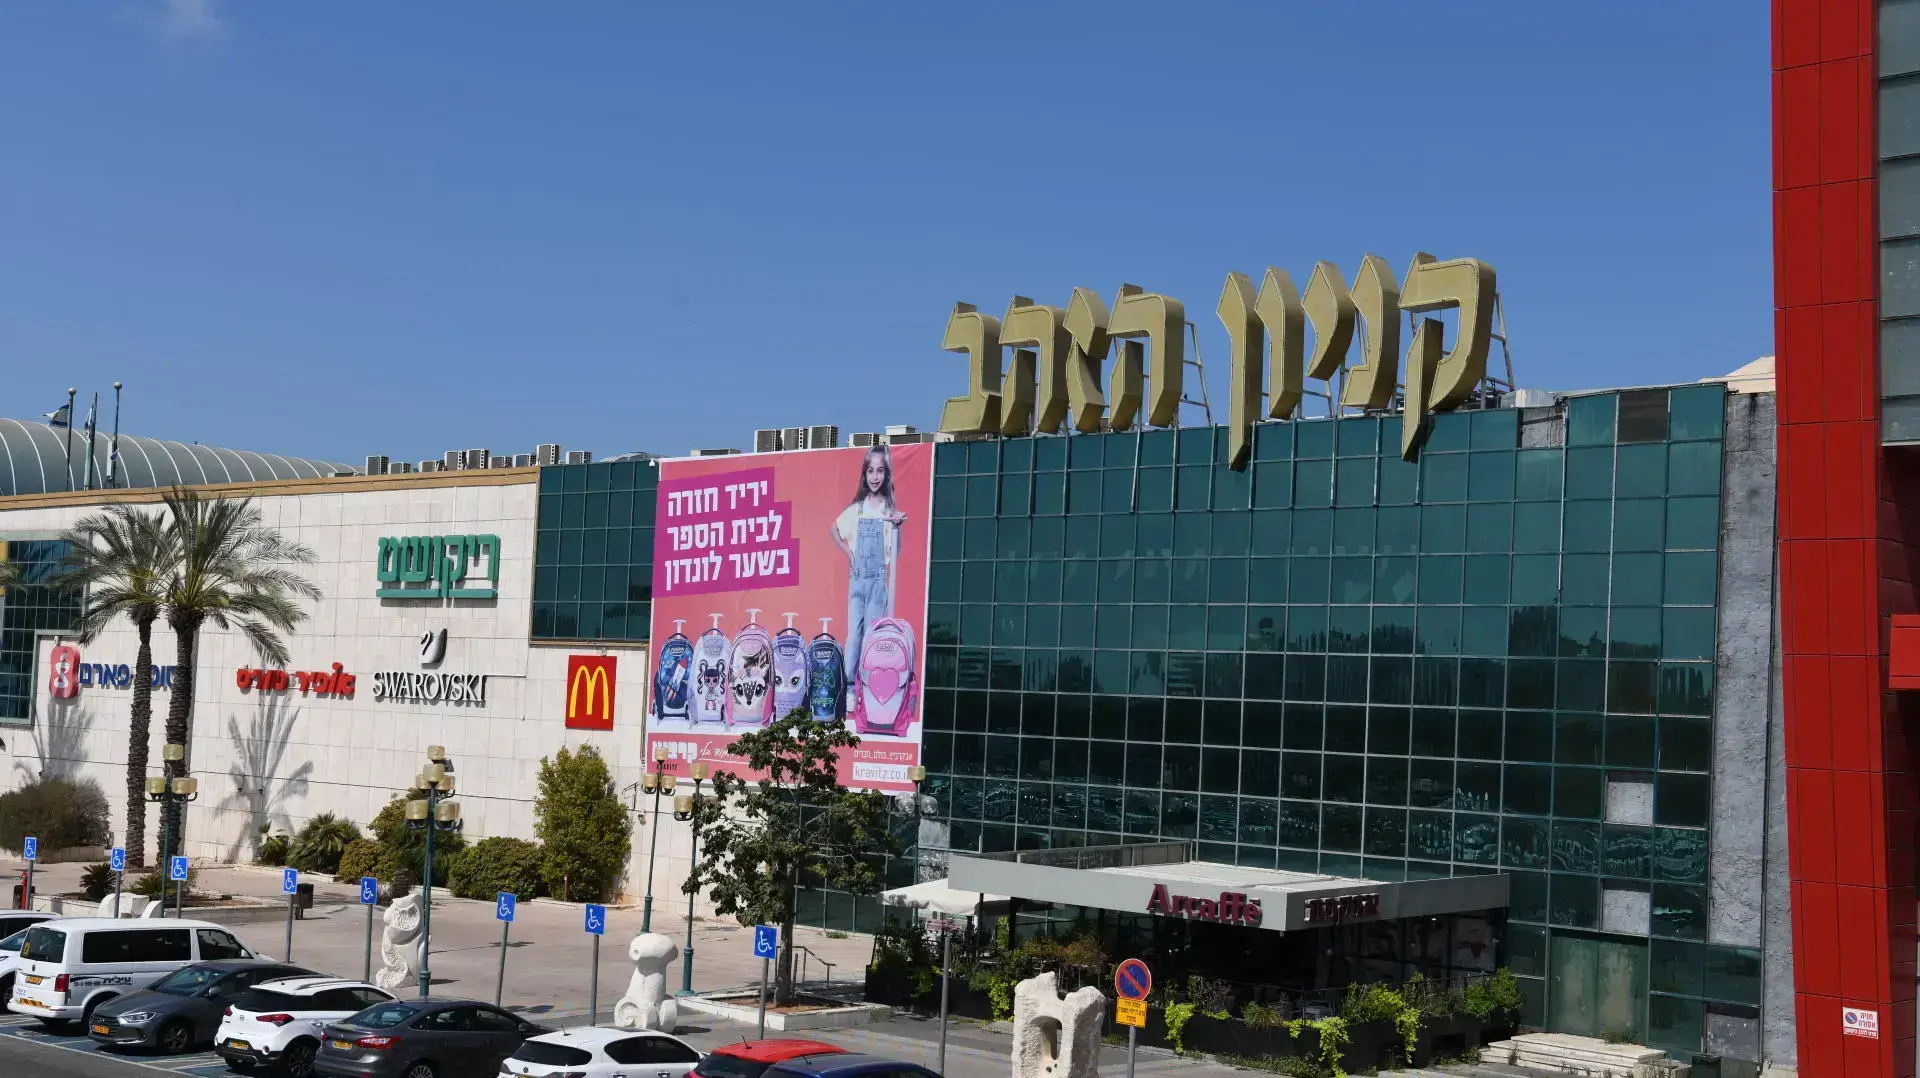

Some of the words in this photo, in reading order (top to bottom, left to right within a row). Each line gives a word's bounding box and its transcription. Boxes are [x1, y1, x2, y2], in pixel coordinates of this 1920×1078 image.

[939, 283, 1186, 436] הזהב
[1216, 251, 1497, 471] קניון
[667, 487, 719, 517] חזרה
[724, 480, 768, 510] יריד
[666, 522, 725, 551] הספר
[730, 509, 783, 545] לבית
[376, 534, 500, 598] ריקושט
[664, 550, 723, 591] לונדון
[728, 548, 790, 579] בשער
[236, 668, 289, 691] טורס
[294, 661, 356, 695] אופיר
[373, 672, 487, 702] SWAROVSKI
[1858, 1020, 1876, 1028] אסורה
[1860, 1012, 1874, 1021] חניה
